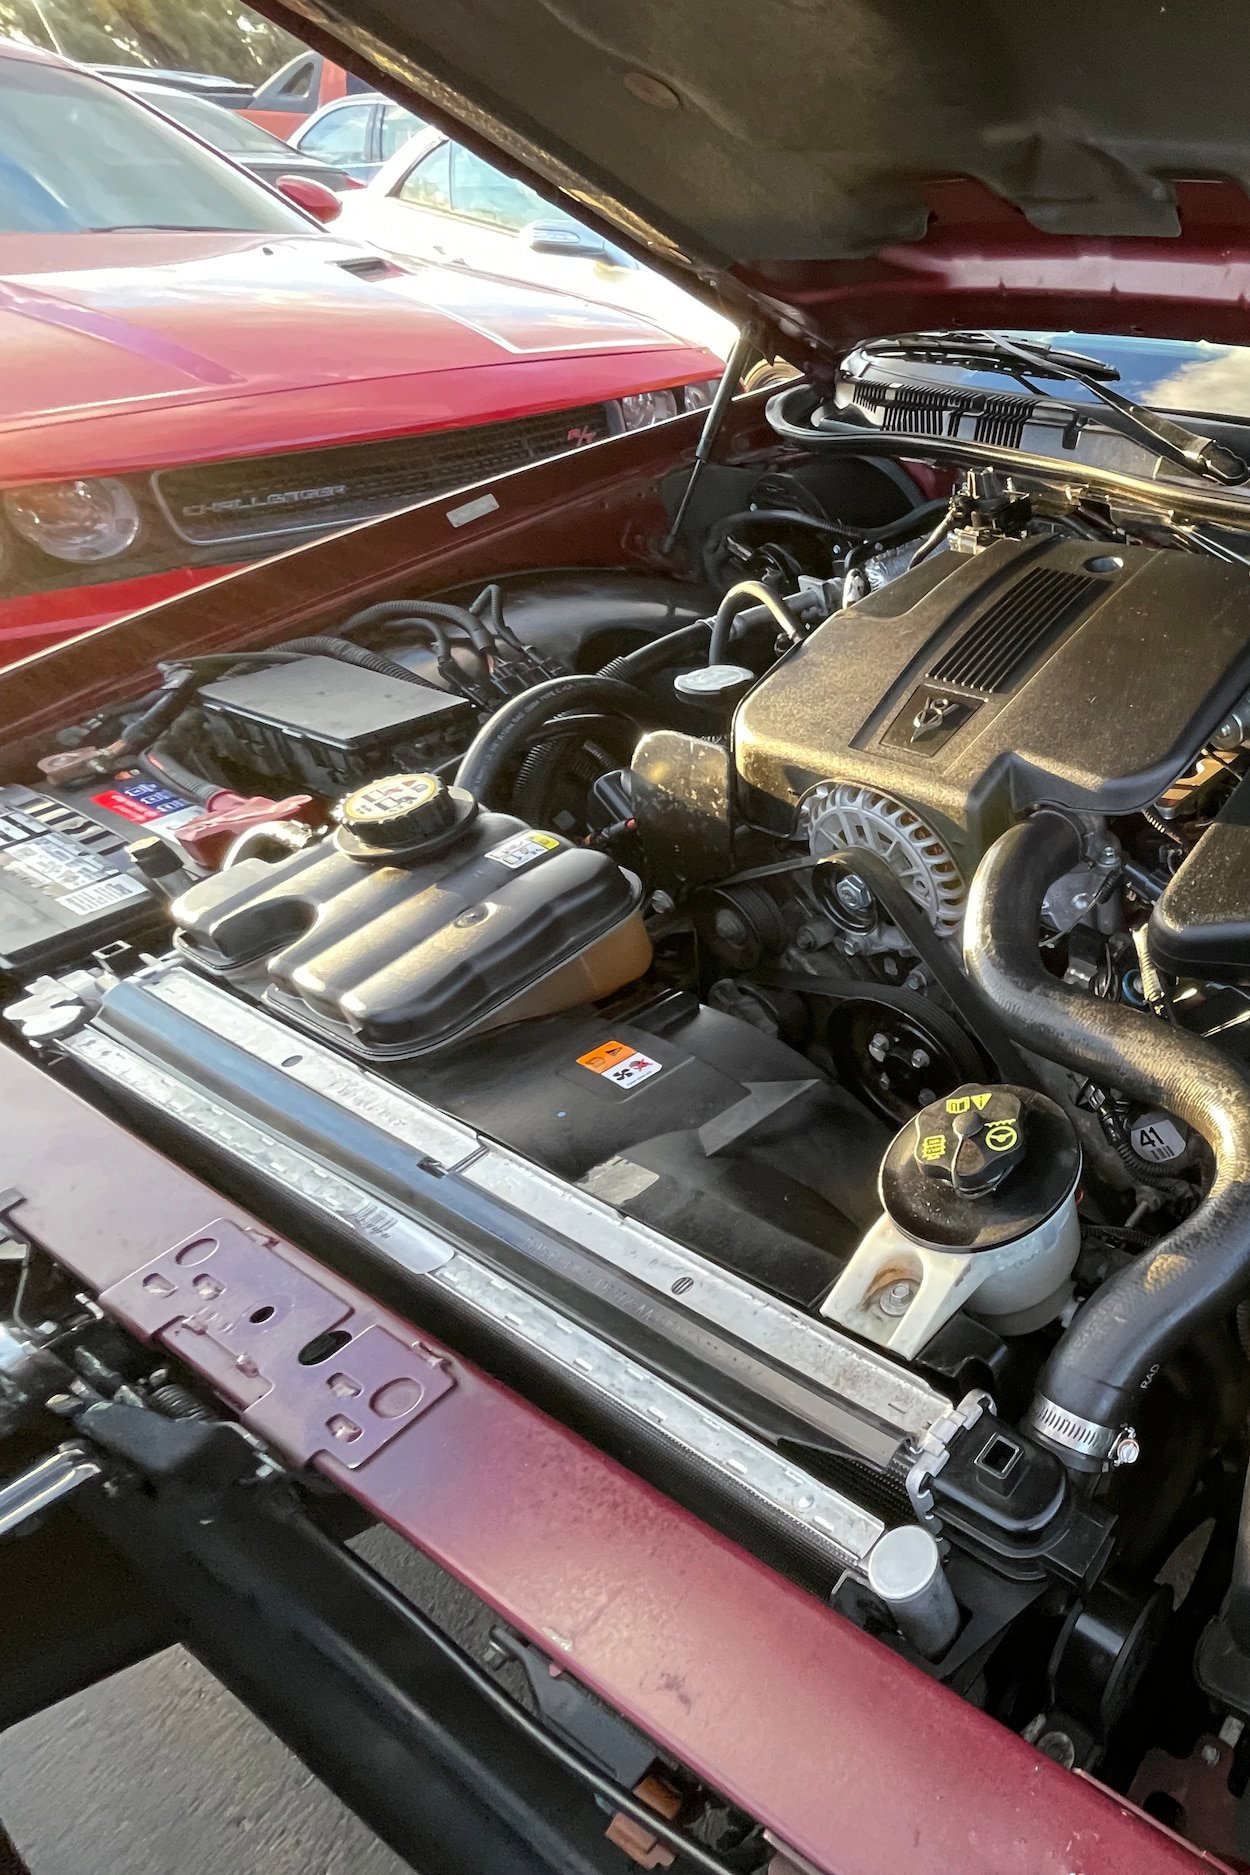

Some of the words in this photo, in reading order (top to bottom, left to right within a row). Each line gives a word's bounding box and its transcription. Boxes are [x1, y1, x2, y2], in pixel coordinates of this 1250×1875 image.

[181, 484, 346, 517] CHALLENGER
[1140, 1126, 1165, 1147] 41
[1140, 1363, 1160, 1389] RAD
